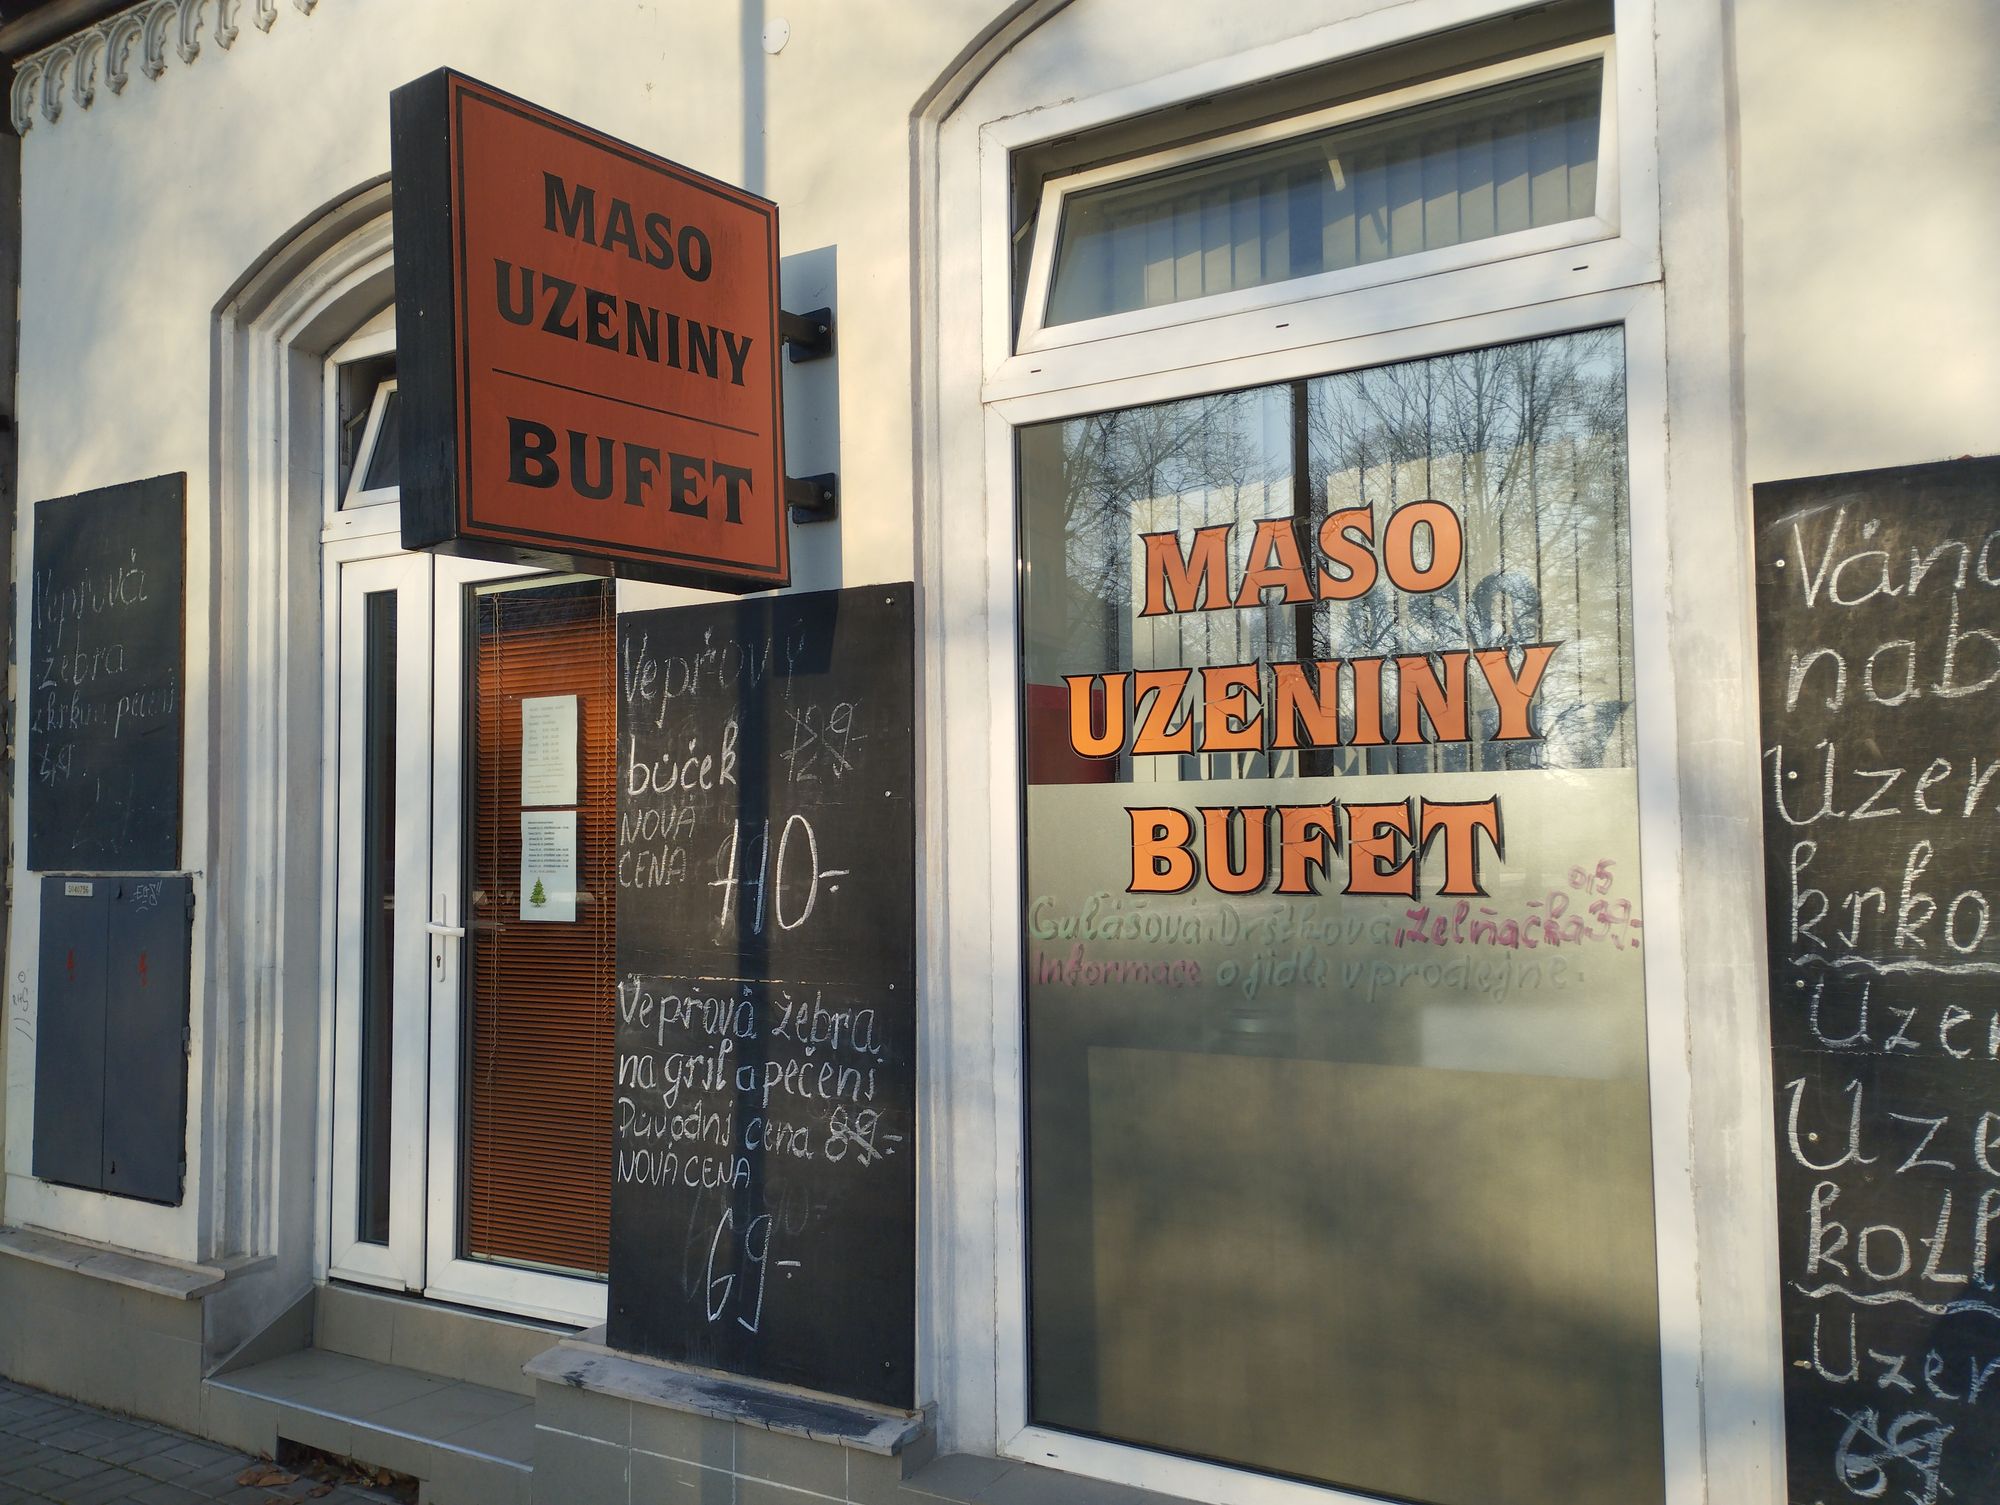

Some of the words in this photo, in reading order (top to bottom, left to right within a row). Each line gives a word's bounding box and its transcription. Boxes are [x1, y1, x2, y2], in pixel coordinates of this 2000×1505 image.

[542, 171, 713, 282] MASO
[494, 257, 754, 387] UZENINY
[506, 416, 754, 525] BUFET
[1138, 500, 1463, 618] MASO
[1061, 640, 1565, 760] UZENINY
[618, 846, 688, 889] CENA
[1124, 795, 1506, 902] BUFET
[618, 1053, 657, 1090] na
[736, 1065, 756, 1091] a
[684, 1153, 751, 1190] CENA
[744, 1116, 814, 1160] cena
